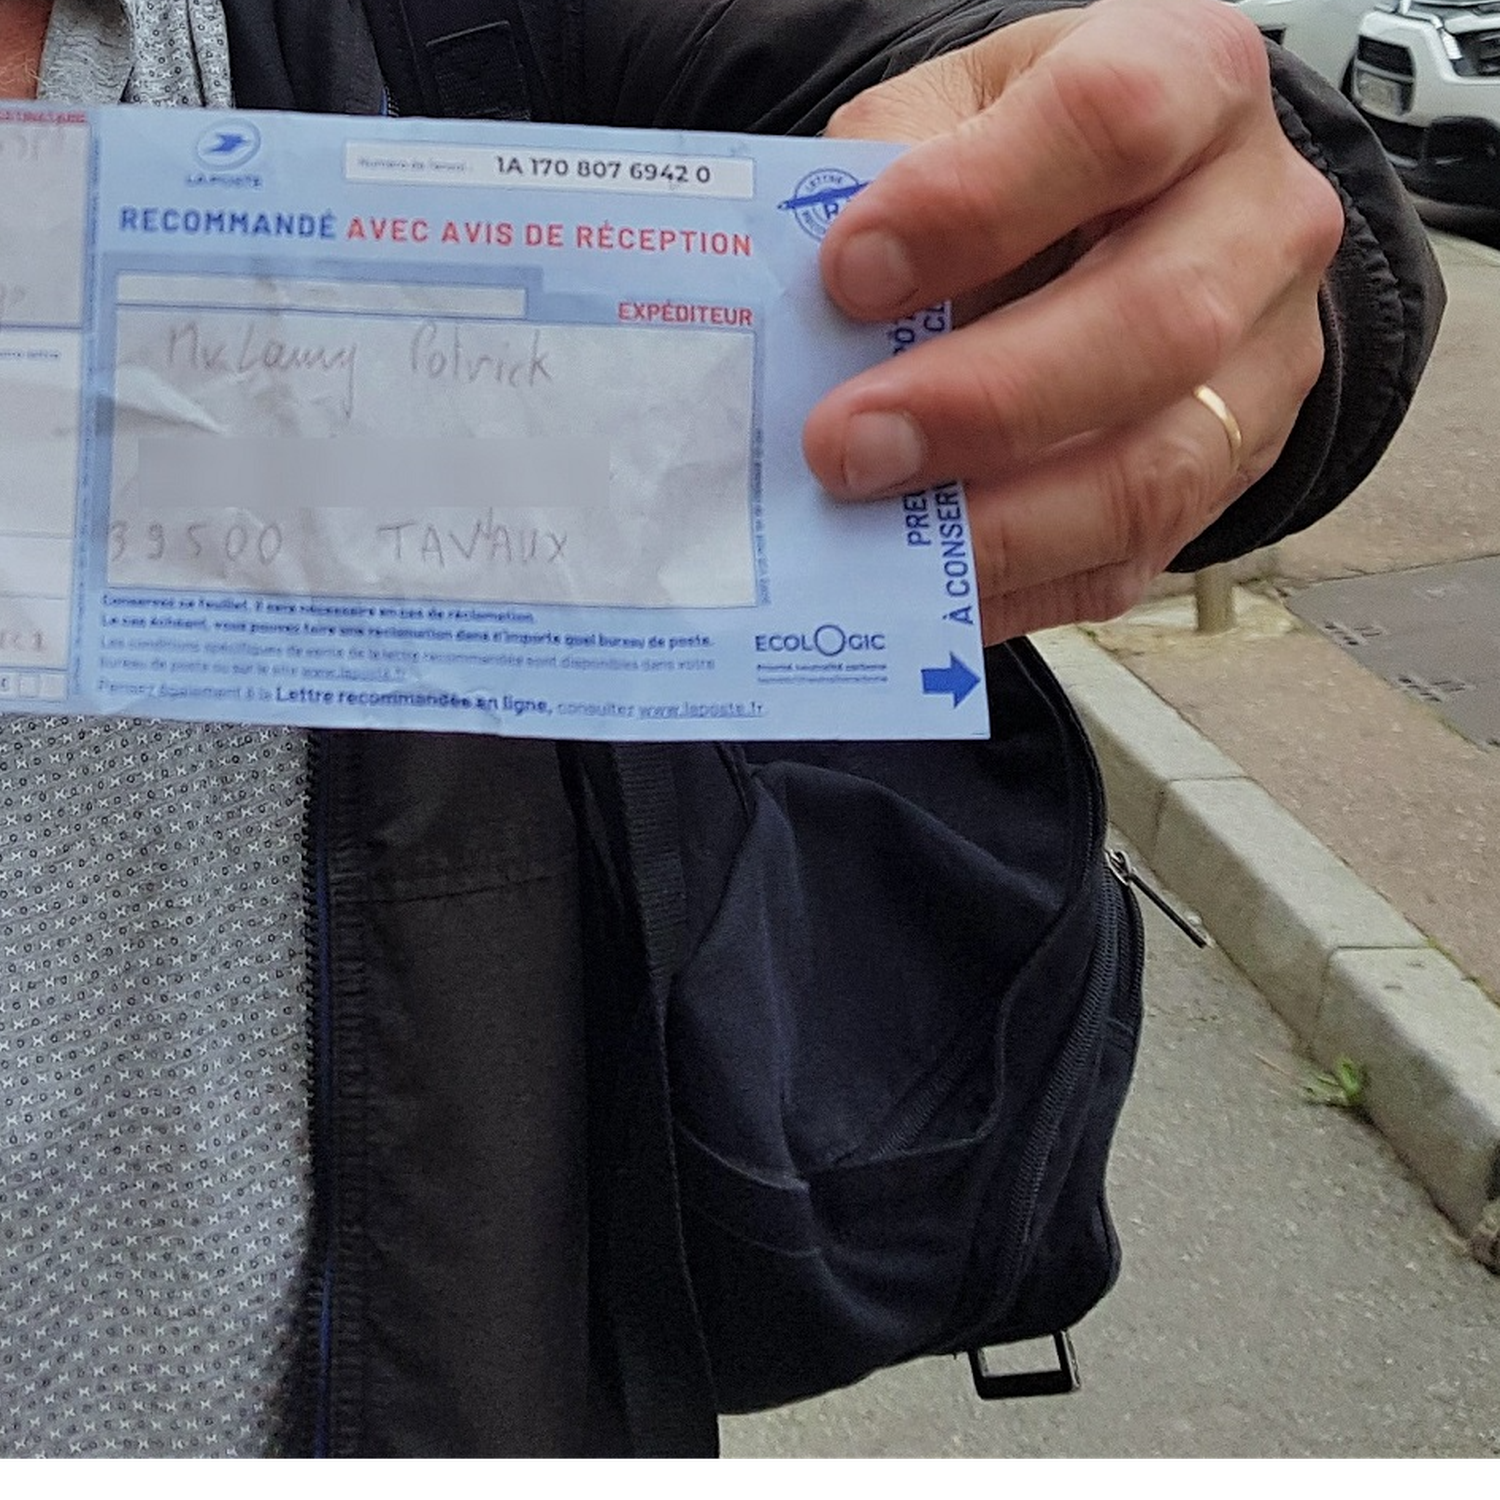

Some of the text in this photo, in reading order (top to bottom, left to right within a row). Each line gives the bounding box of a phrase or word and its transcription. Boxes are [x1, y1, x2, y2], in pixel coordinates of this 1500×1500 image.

[496, 156, 712, 184] 1A 170 807 6942 0
[120, 207, 753, 257] RECOMMANDÉ AVEC AVIS DE RÉCEPTION
[617, 299, 753, 327] EXPÉDITEUR
[109, 519, 284, 566] 39500
[943, 605, 974, 626] À
[755, 625, 886, 656] ECOLOGIC
[276, 686, 334, 703] Lettre
